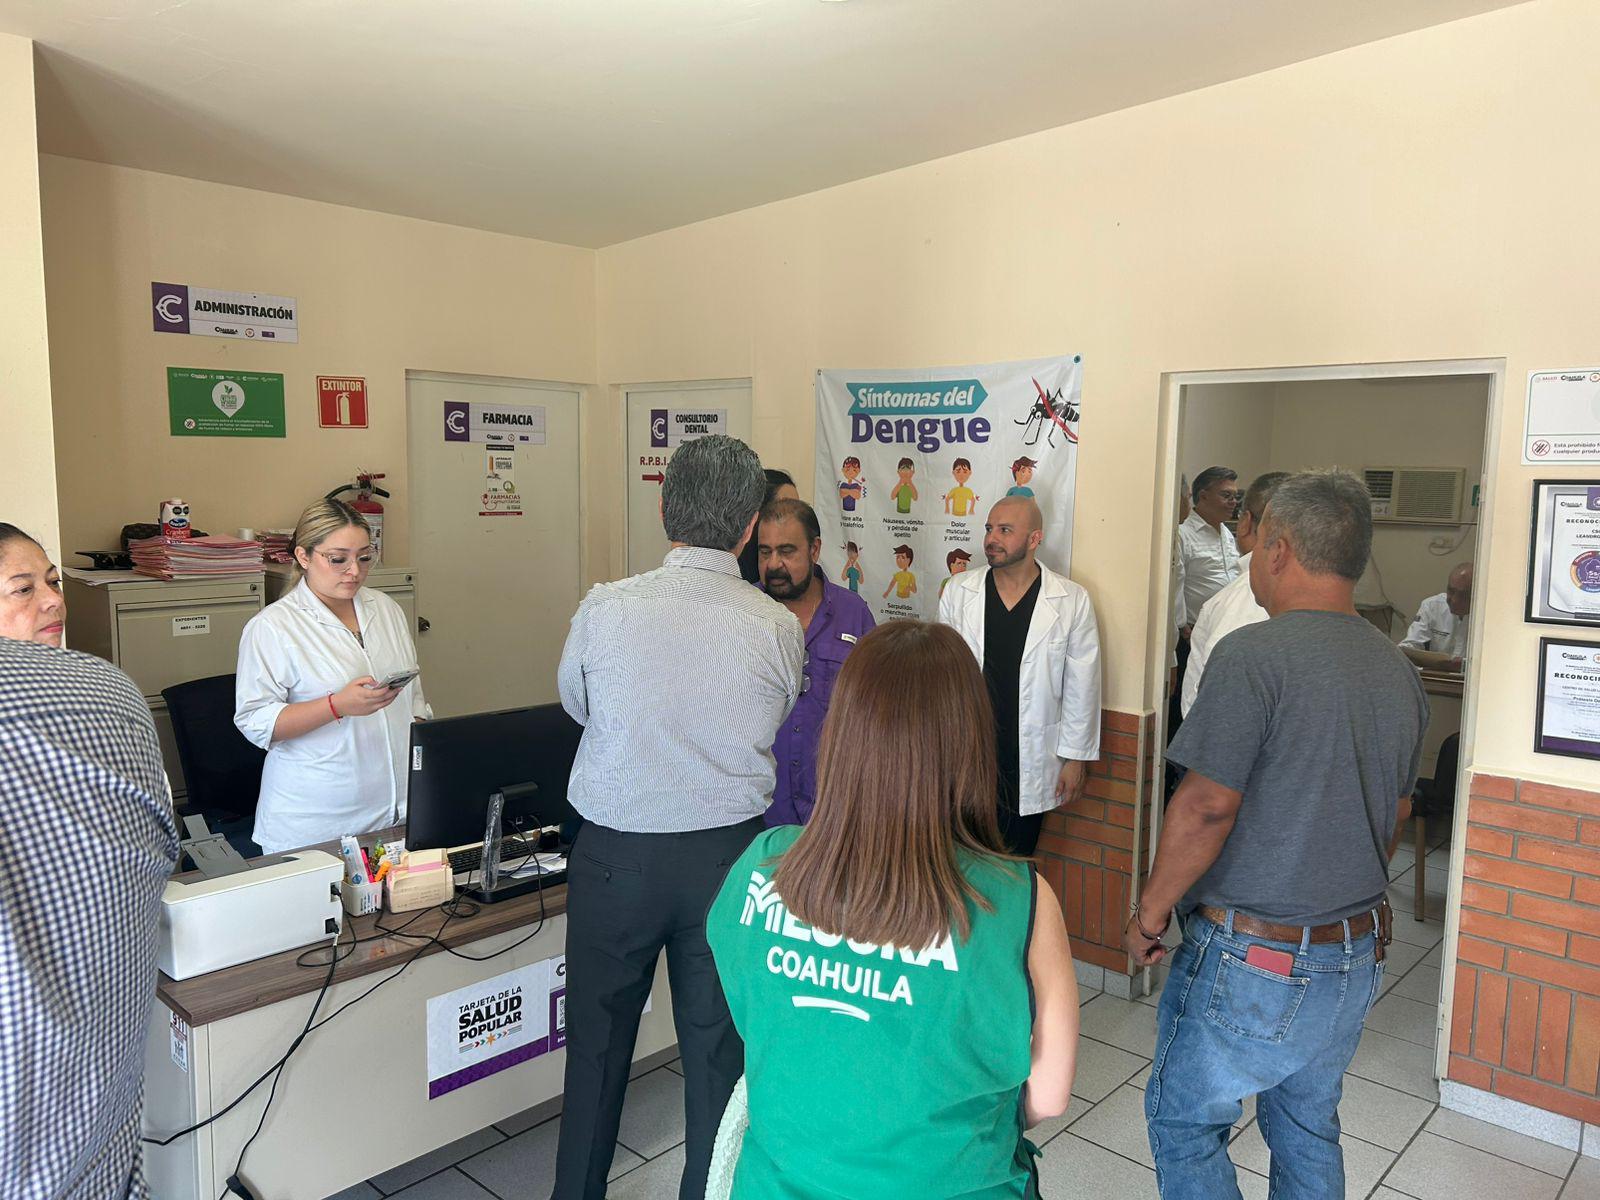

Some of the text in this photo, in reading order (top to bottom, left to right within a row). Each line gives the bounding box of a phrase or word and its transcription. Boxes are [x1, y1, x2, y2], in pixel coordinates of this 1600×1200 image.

[194, 300, 293, 320] ADMINISTRACIÓN
[322, 380, 362, 391] EXTINTOR
[858, 385, 975, 409] Síntomas del
[482, 413, 533, 426] FARMACIA
[675, 414, 719, 423] CONSULTORIO
[684, 425, 709, 433] DENTAL
[851, 413, 991, 453] Dengue
[766, 945, 913, 1006] COAHUILA
[459, 986, 522, 1013] TARJETA DE LA
[459, 995, 522, 1030] SALUD
[459, 1011, 522, 1043] POPULAR
